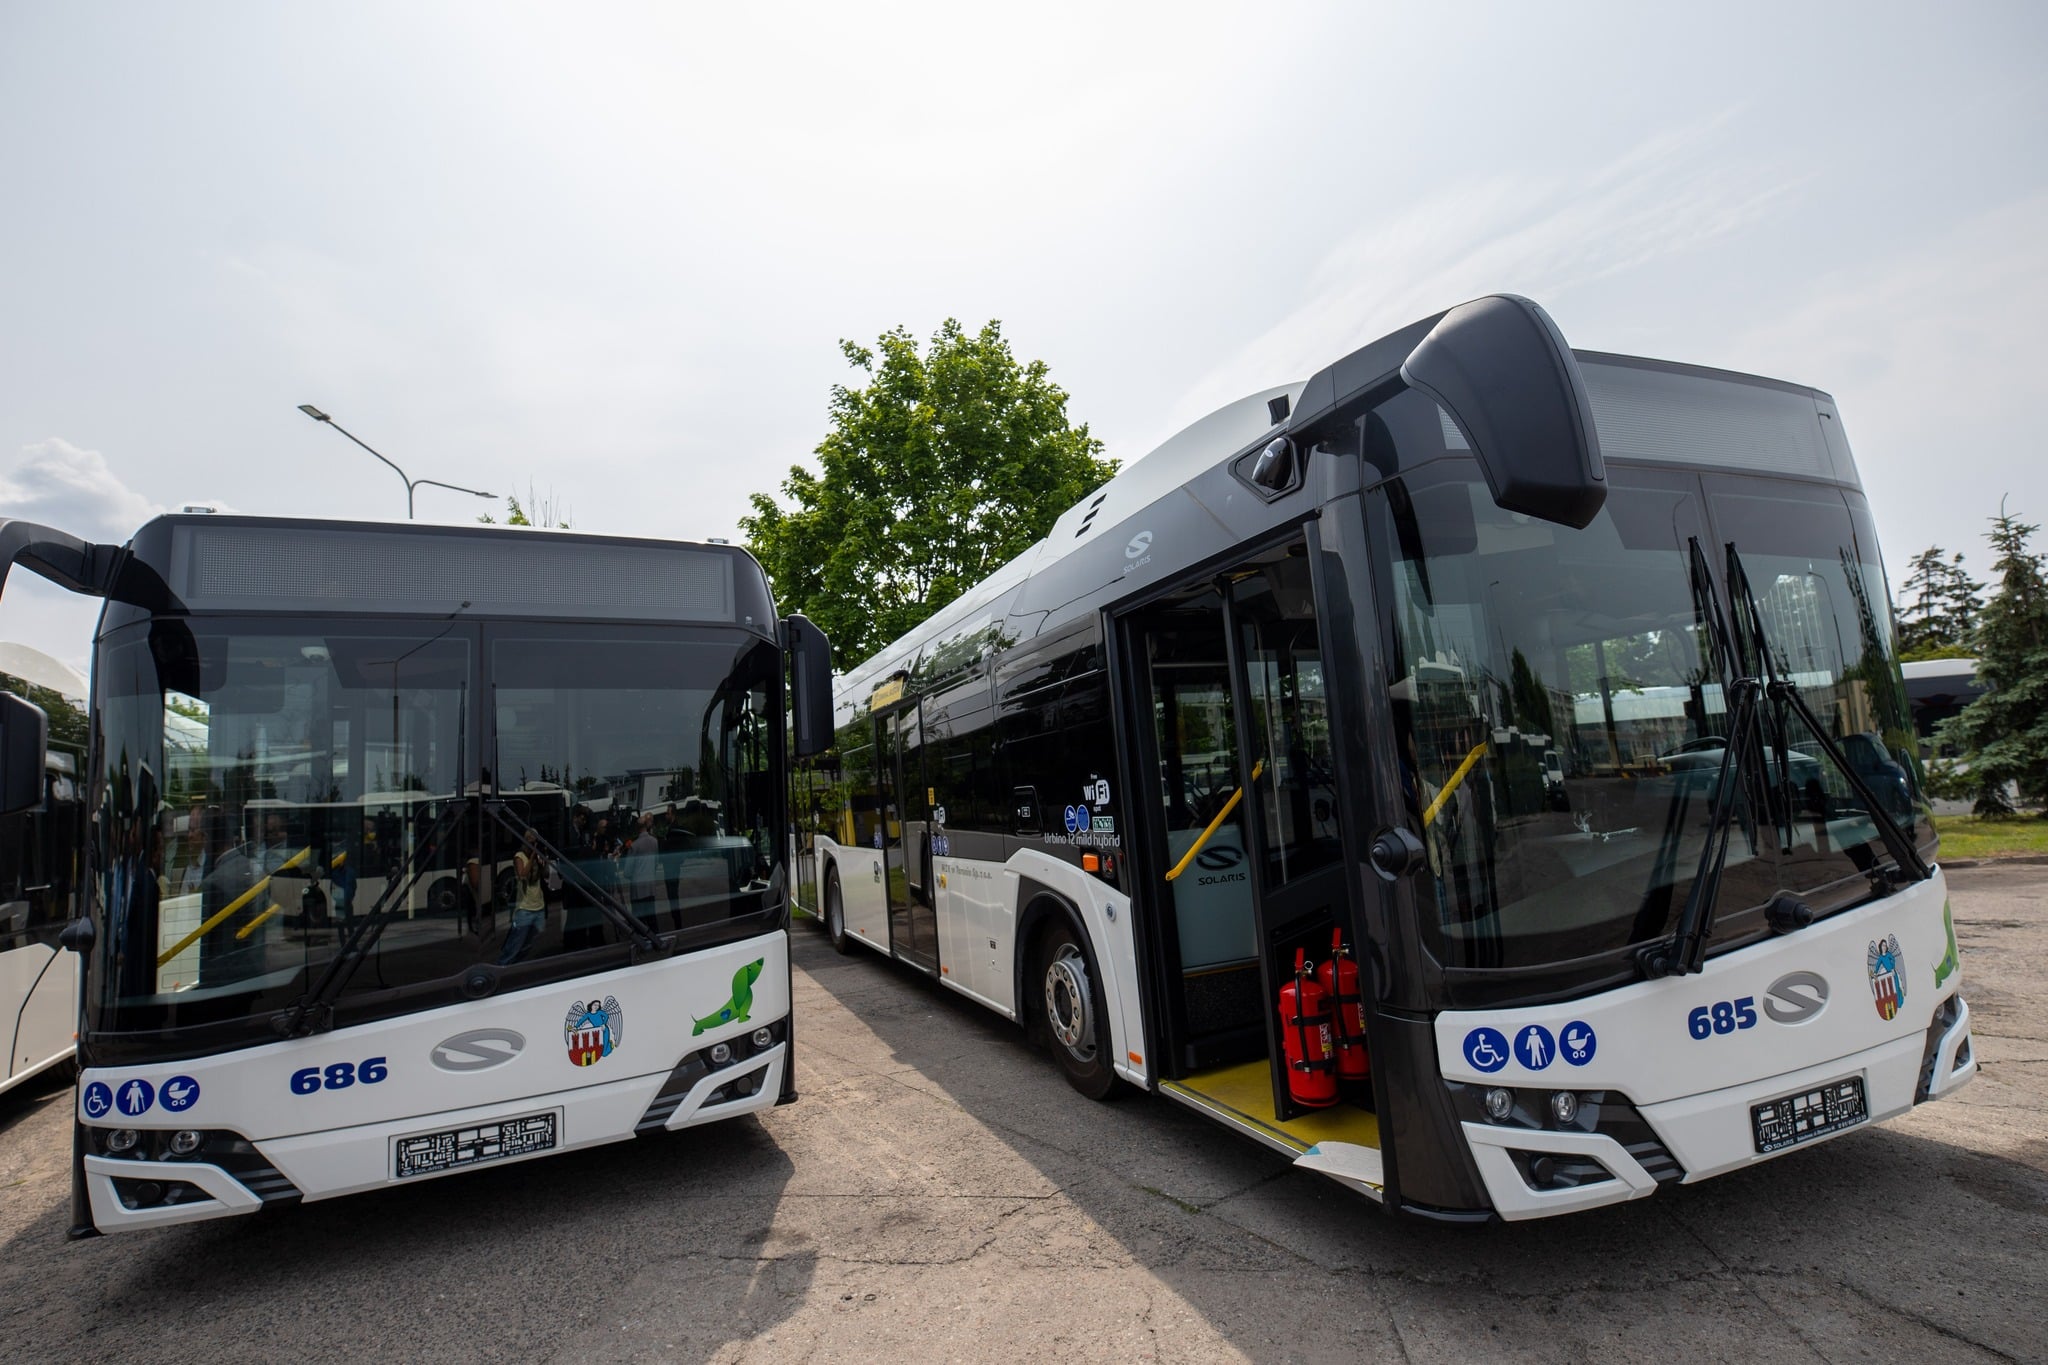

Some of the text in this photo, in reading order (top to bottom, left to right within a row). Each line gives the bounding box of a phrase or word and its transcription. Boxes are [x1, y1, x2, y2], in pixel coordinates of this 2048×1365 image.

[1122, 554, 1152, 575] SOLARIS
[1044, 832, 1121, 849] Urbino 12 mild hybrid
[1198, 872, 1246, 886] SOLARIS
[1687, 995, 1758, 1041] 685
[290, 1056, 388, 1096] 686
[1773, 1139, 1795, 1149] SOLARIS
